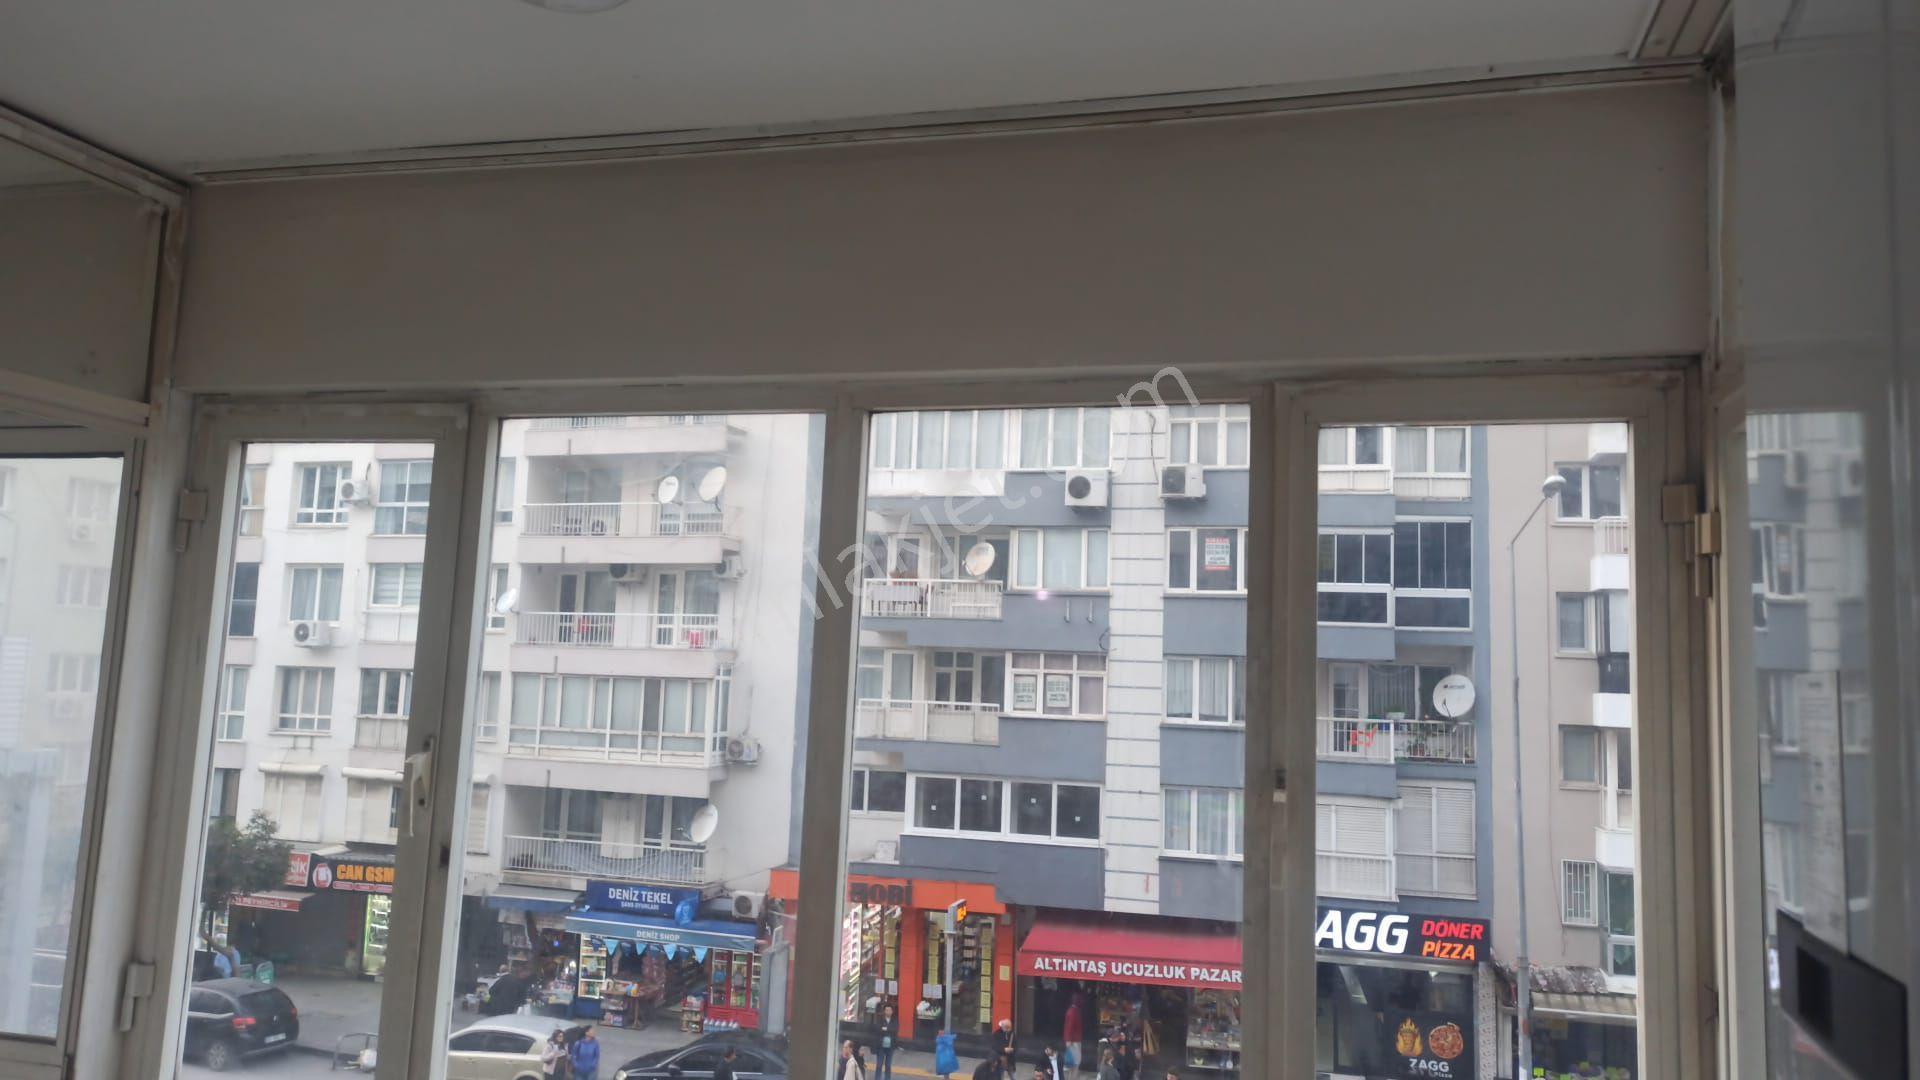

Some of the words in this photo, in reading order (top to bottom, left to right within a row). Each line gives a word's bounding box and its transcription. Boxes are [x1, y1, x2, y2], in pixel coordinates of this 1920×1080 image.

[336, 864, 363, 881] CAN
[365, 866, 394, 883] GSM
[608, 887, 638, 901] DENİZ
[640, 891, 673, 904] TEKEL
[1315, 910, 1409, 953] AGG
[1421, 919, 1484, 940] DÖNER
[1421, 940, 1476, 961] PİZZA
[1034, 957, 1107, 977] ALTINTAŞ
[1111, 962, 1186, 980] UCUZLUK
[1409, 1058, 1450, 1073] ZAGG
